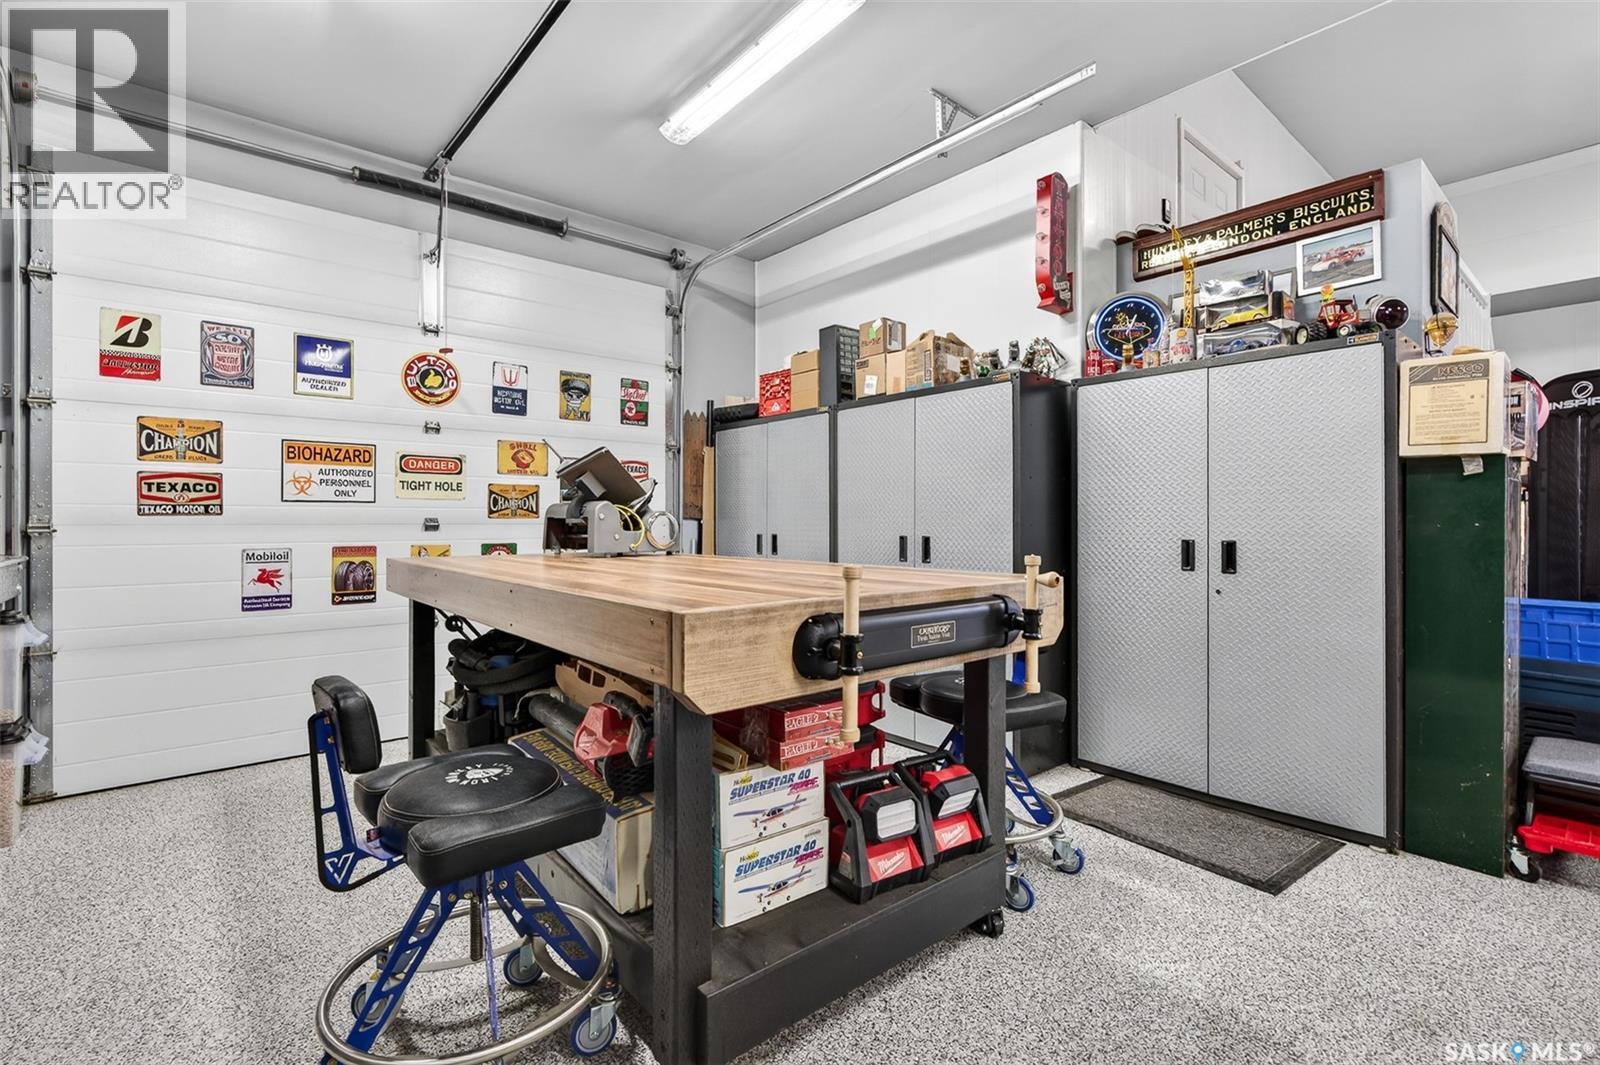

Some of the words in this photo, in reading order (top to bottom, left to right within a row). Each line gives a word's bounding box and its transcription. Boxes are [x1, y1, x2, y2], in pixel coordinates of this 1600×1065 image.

[1216, 211, 1287, 241] PALMER'S
[1293, 188, 1375, 219] BISCUITS.
[1289, 201, 1375, 231] ENGLAND.
[406, 356, 457, 390] BULTACO
[301, 377, 347, 388] AUTHORIZED
[310, 383, 339, 392] DEALER
[509, 441, 537, 452] SHELL
[286, 445, 372, 464] BIOHAZARD
[408, 459, 455, 471] DANGER
[318, 468, 374, 478] AUTHORIZED
[143, 481, 217, 493] TEXACO
[319, 478, 372, 488] PERSONNEL
[400, 480, 430, 492] TIGHT
[434, 481, 463, 492] HOLE
[333, 489, 357, 498] ONLY
[139, 504, 174, 514] TEXACO
[176, 505, 206, 514] MOTOR
[208, 505, 221, 514] OIL
[245, 551, 289, 561] Mobiloil
[730, 772, 796, 800] SUPERSTAR
[798, 768, 811, 780] 40
[735, 844, 801, 877] SUPERSTAR
[803, 839, 817, 852] 40
